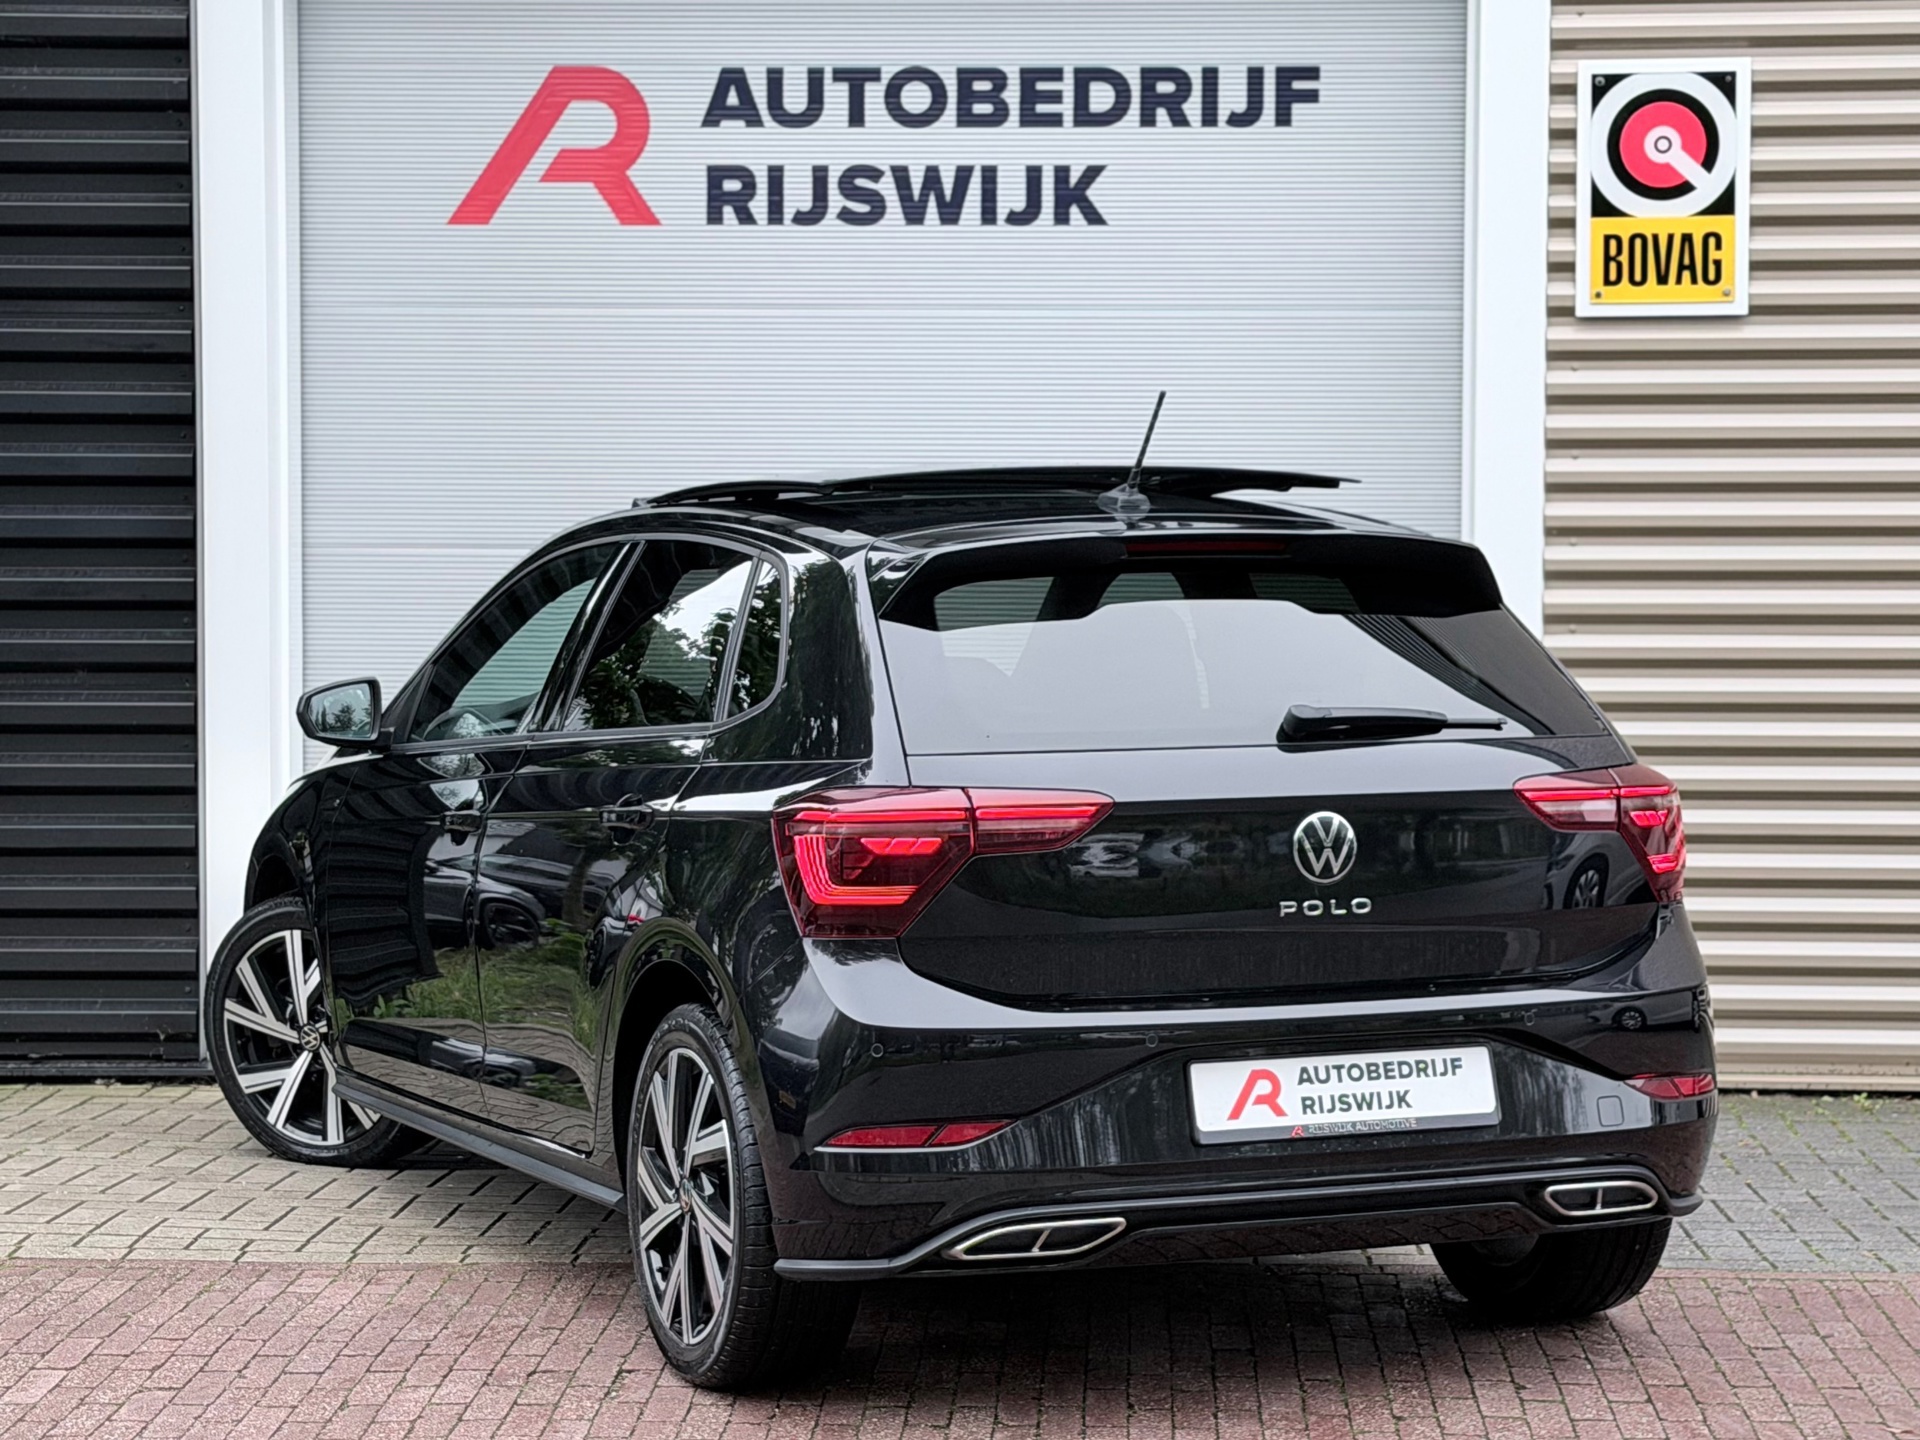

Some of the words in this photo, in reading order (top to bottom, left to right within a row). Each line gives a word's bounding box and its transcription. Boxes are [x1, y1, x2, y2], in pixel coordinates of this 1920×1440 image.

[701, 66, 1321, 128] AUTOBEDRIJF
[706, 164, 1108, 226] RIJSWIJK
[1603, 231, 1723, 287] BOVAG
[1279, 897, 1372, 918] POLO
[1297, 1057, 1464, 1086] AUTOBEDRIJF
[1301, 1089, 1413, 1115] RIJSWIJK
[1308, 1120, 1354, 1134] RIJSWIJK
[1355, 1117, 1418, 1131] AUTOMOTIVE
